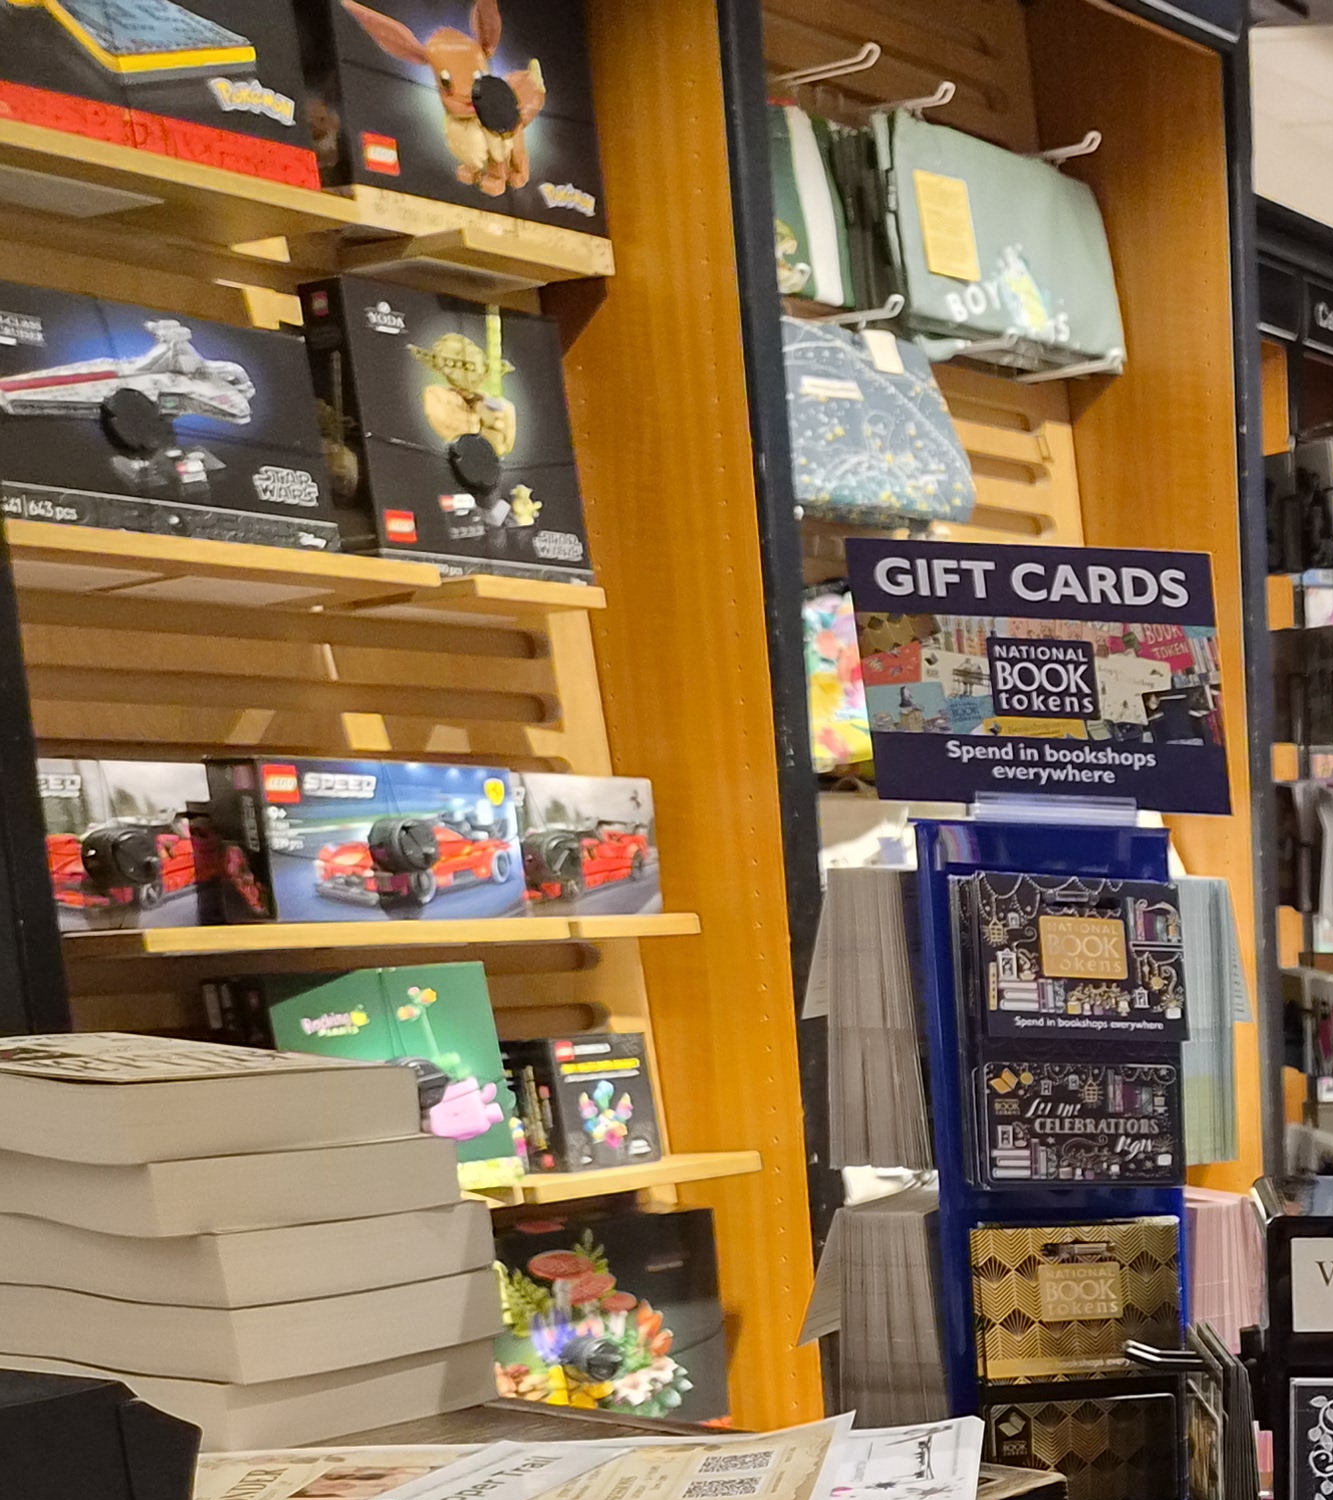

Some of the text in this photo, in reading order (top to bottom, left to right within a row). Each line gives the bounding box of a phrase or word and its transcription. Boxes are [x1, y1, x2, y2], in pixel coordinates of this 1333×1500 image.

[874, 557, 1190, 608] GIFT CARDS
[993, 645, 1088, 662] NATIONAL
[996, 661, 1092, 694] BOOK
[1000, 690, 1094, 714] tokens
[946, 740, 1157, 769] Spend in bookshops
[268, 772, 377, 794] LEGO SPEED
[991, 763, 1116, 785] everywhere
[1047, 922, 1119, 935] NATIONAL
[1047, 934, 1120, 958] BOOK
[1014, 1016, 1044, 1028] Spend
[1047, 1017, 1056, 1027] in
[1057, 1017, 1108, 1029] bookshops
[1034, 1118, 1159, 1134] CELEBRATIONS
[1048, 1268, 1116, 1279] NATIONAL
[1045, 1279, 1117, 1301] BOOK
[1049, 1300, 1118, 1315] tokens
[499, 1452, 562, 1484] Trail
